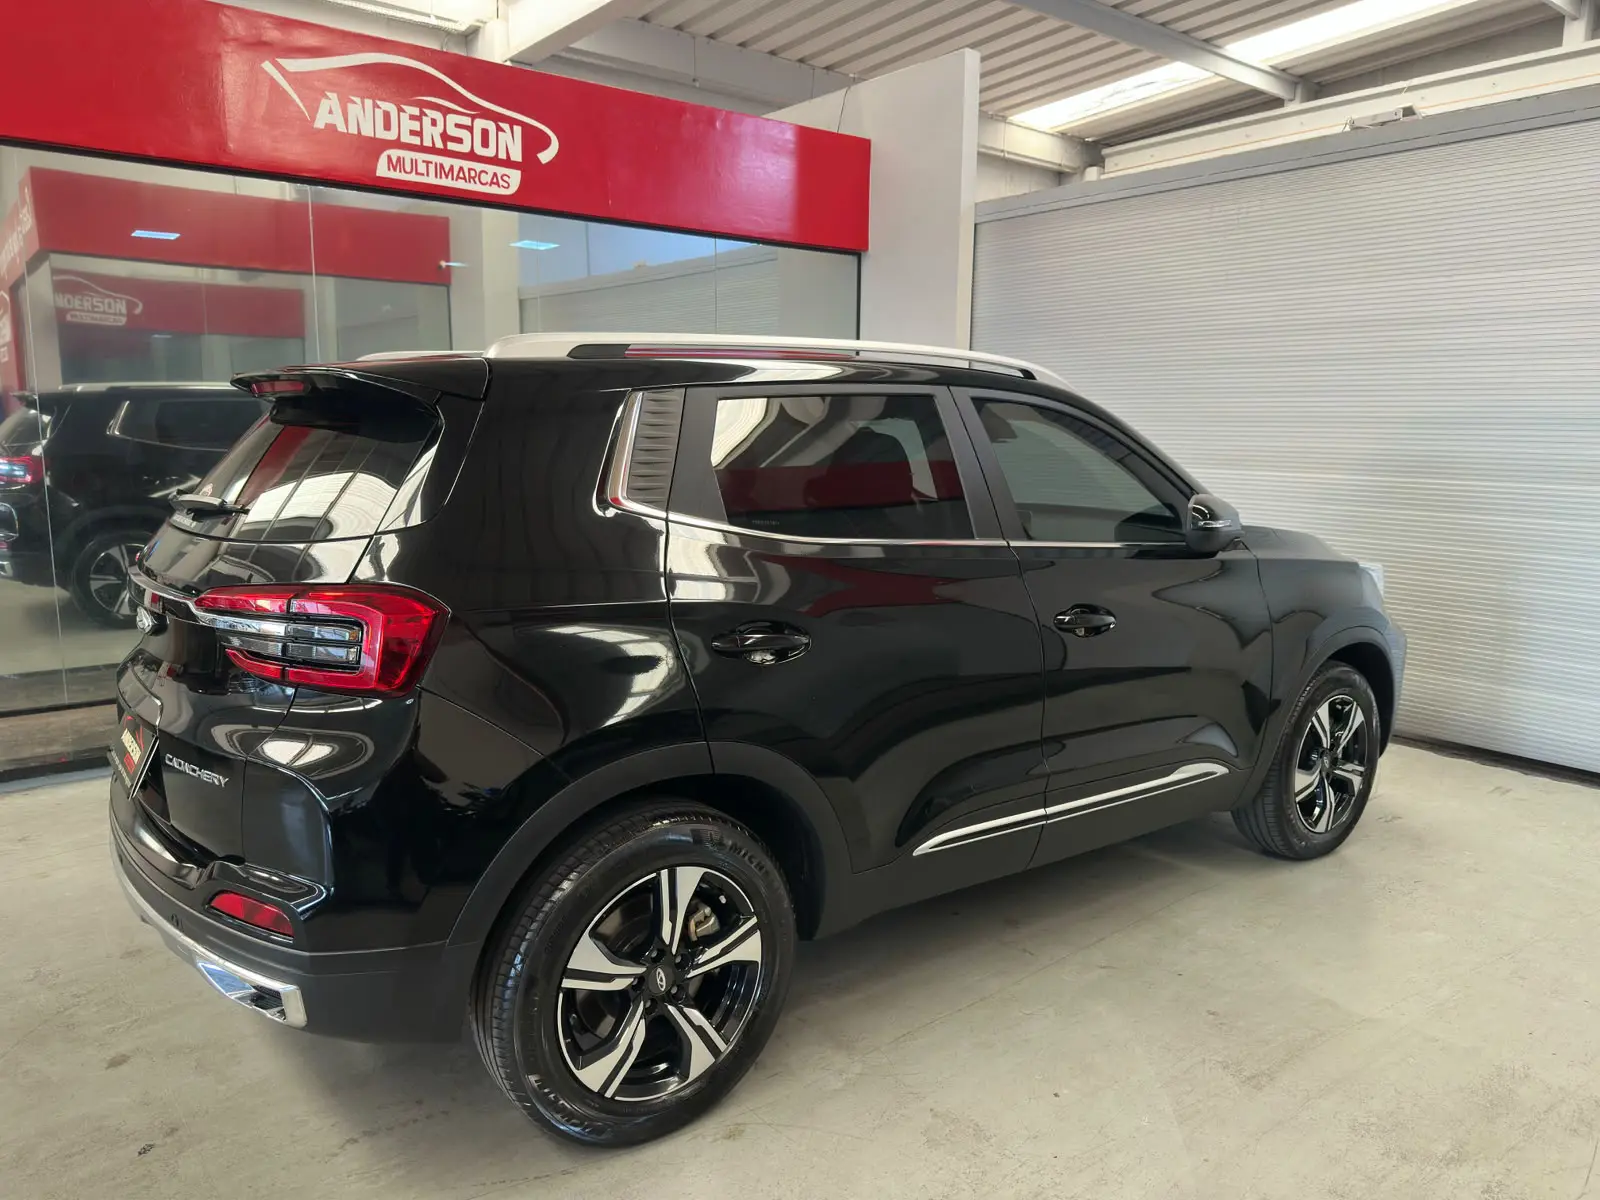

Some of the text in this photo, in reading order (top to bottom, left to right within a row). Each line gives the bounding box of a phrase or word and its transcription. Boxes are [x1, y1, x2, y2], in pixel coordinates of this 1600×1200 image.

[314, 91, 523, 163] ANDERSON
[386, 154, 511, 190] MULTIMARCAS
[54, 292, 127, 315] NDERSON
